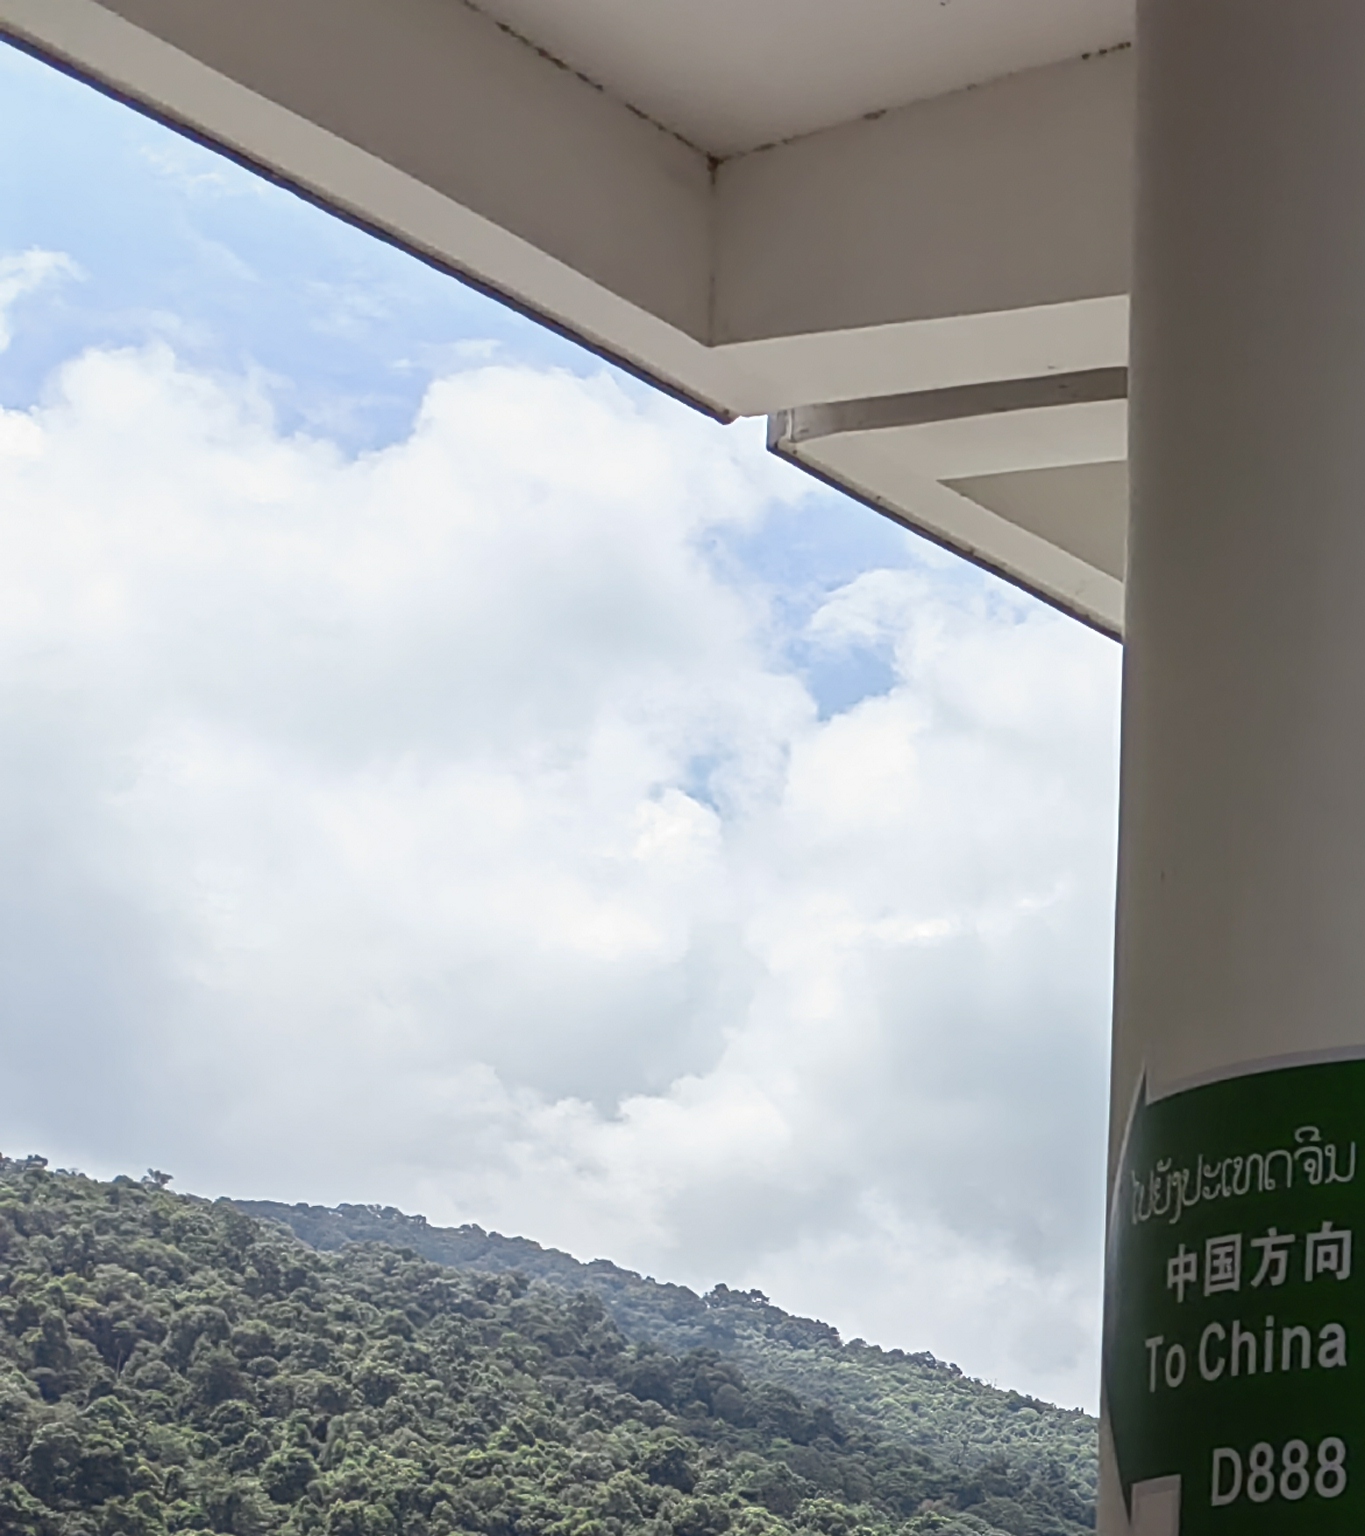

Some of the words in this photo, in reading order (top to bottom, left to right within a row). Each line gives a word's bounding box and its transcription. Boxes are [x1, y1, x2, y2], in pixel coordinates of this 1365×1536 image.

[1166, 1220, 1352, 1303] 中国方向
[1145, 1335, 1187, 1392] To
[1199, 1315, 1347, 1382] China
[1211, 1436, 1348, 1507] D888
